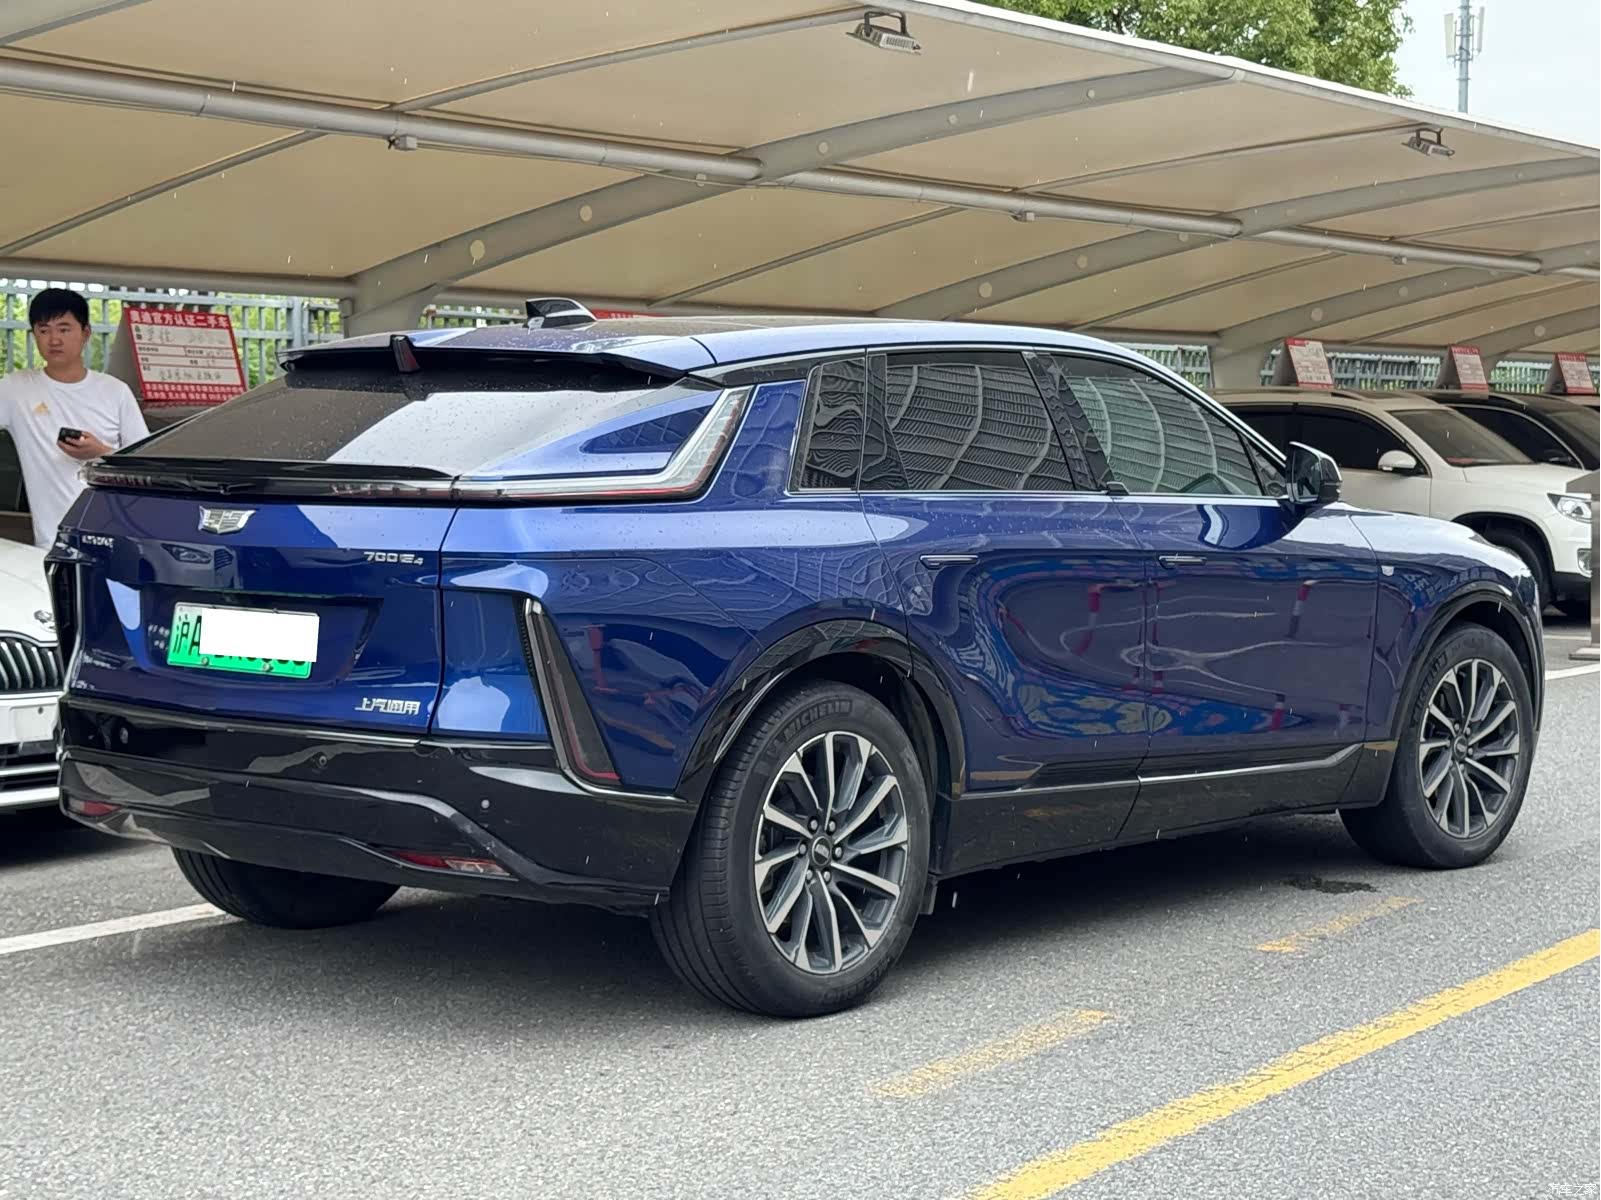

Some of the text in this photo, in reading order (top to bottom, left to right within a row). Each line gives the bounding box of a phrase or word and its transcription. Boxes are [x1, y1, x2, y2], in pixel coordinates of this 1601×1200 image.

[354, 697, 421, 716] 上汽通用
[783, 700, 852, 742] MICHELIN
